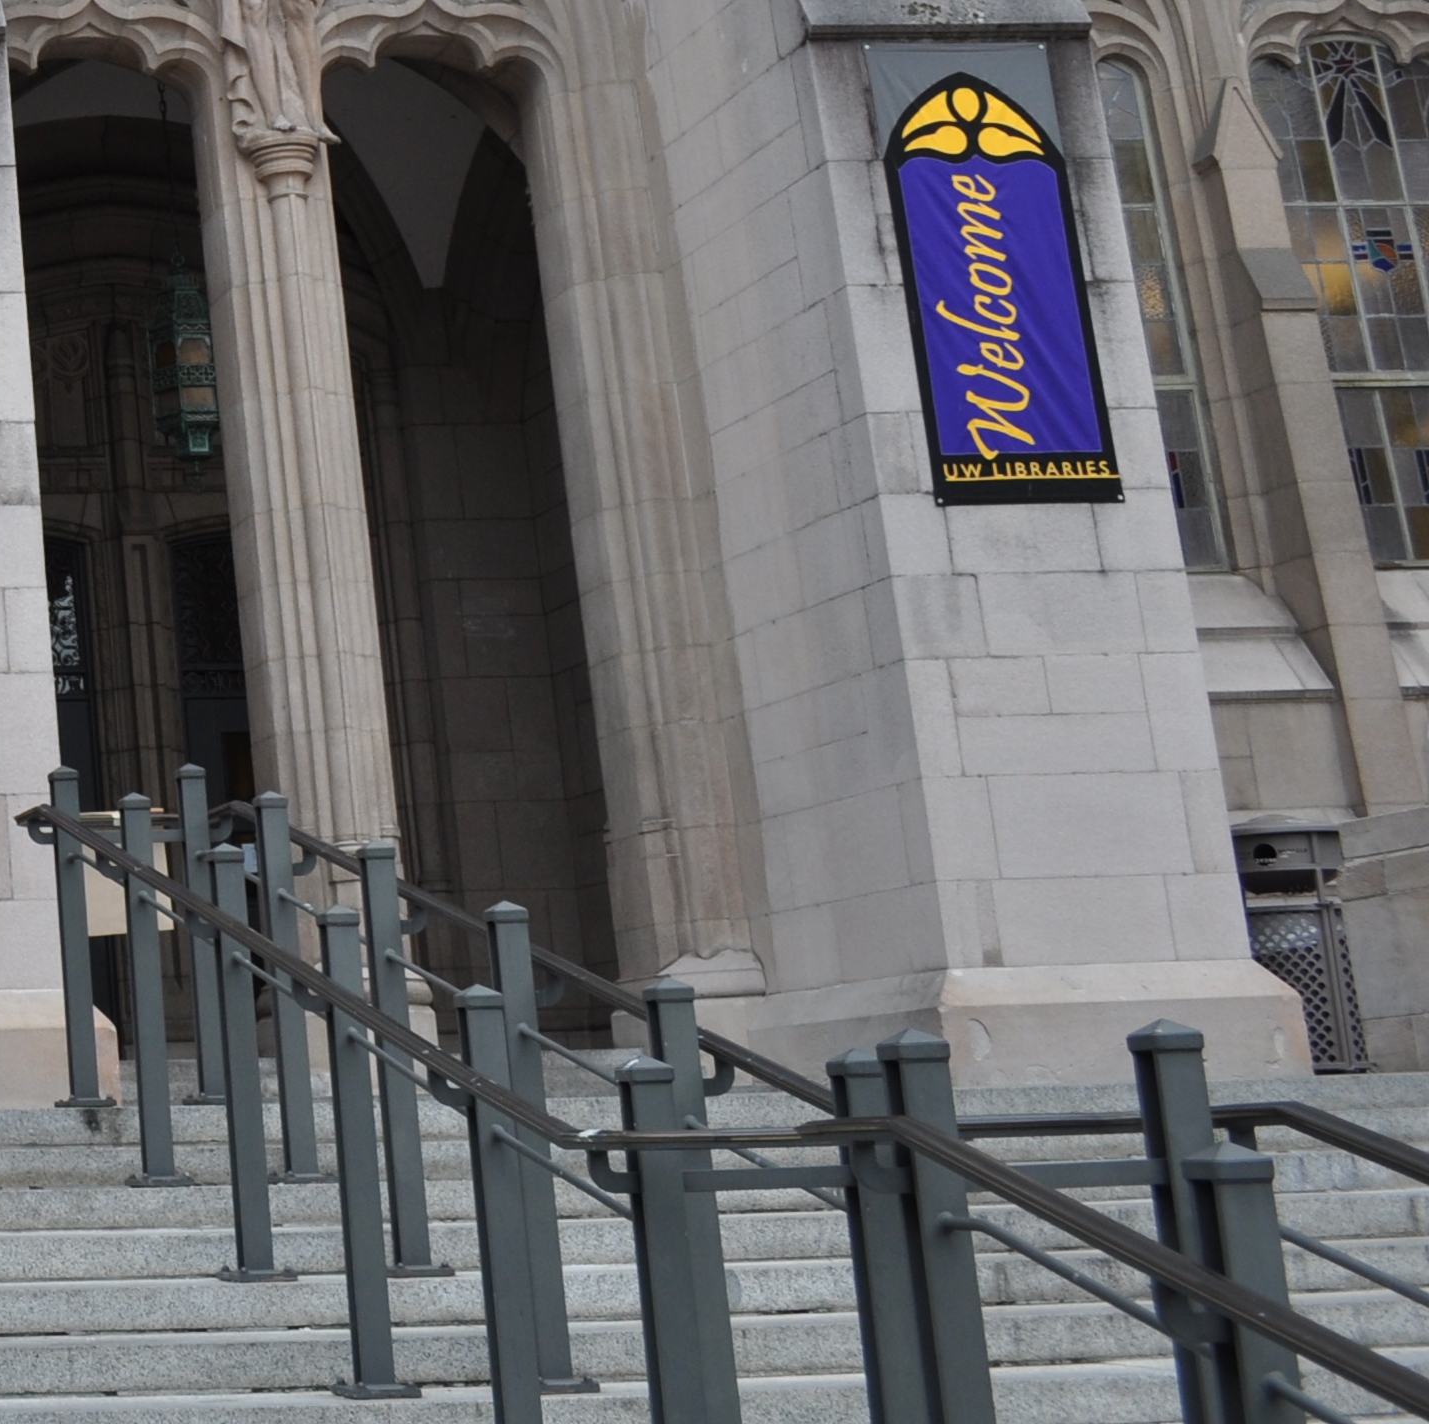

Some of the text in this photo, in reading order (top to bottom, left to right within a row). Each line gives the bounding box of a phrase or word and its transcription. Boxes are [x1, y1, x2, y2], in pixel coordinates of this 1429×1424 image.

[936, 174, 1036, 460] Welcome
[943, 460, 1111, 478] UW LIBRARIES
